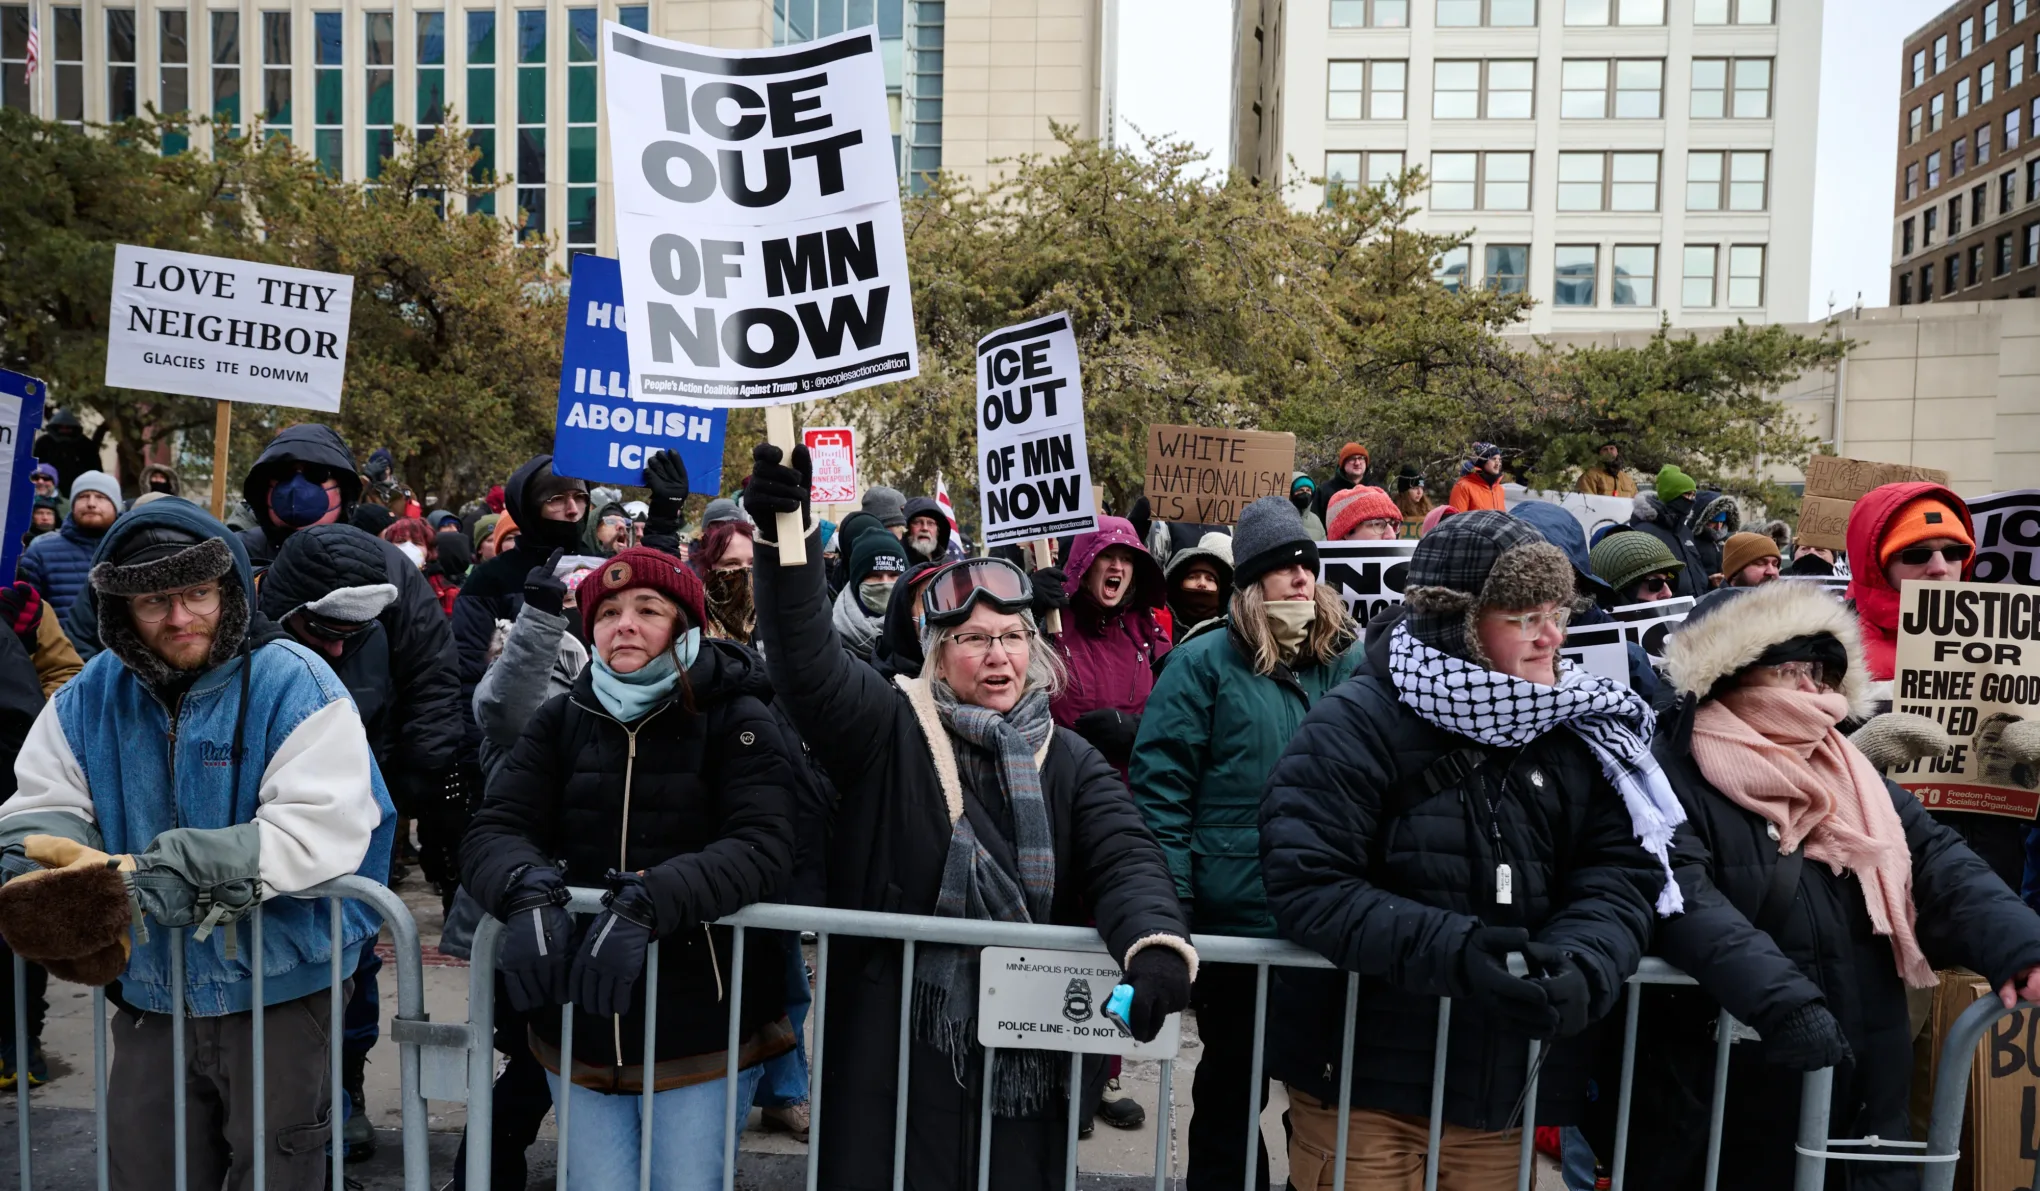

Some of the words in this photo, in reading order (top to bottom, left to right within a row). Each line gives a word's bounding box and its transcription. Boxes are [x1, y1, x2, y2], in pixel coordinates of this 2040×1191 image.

[660, 72, 833, 141] ICE
[641, 129, 863, 208] OUT
[649, 233, 745, 299] OF
[761, 221, 879, 298] MN
[132, 261, 236, 300] LOVE
[258, 278, 338, 313] THY
[126, 304, 339, 360] NEIGHBOR
[647, 285, 890, 369] NOW
[143, 352, 206, 370] GLACIES
[216, 361, 239, 374] ITE
[250, 365, 308, 384] DOMVM
[644, 378, 678, 390] People's
[678, 381, 702, 394] Action
[703, 382, 738, 395] Coalition
[739, 383, 771, 397] Against
[772, 381, 798, 393] Trump
[814, 358, 907, 388] @peoplesactioncoalition
[986, 339, 1052, 390] ICE
[564, 402, 712, 443] ABOLISH
[983, 378, 1066, 431] OUT
[986, 445, 1016, 485] OF
[1022, 434, 1075, 478] MN
[1158, 432, 1246, 464] WHITE
[987, 474, 1081, 525] NOW
[1150, 496, 1184, 520] IS
[1934, 641, 2022, 666] FOR
[1900, 668, 1976, 700] RENEE
[1980, 672, 2040, 705] GOOD
[1946, 798, 1980, 806] Socialist
[1980, 800, 2033, 814] Organization
[1948, 790, 1982, 799] Freedom
[1984, 792, 2006, 802] Road
[1006, 963, 1062, 974] MINNEAPOLIS
[1064, 966, 1094, 976] POLICE
[998, 1021, 1036, 1032] POLICE
[1040, 1023, 1064, 1034] LINE
[1074, 1026, 1089, 1036] DO
[1092, 1028, 1116, 1038] NOT
